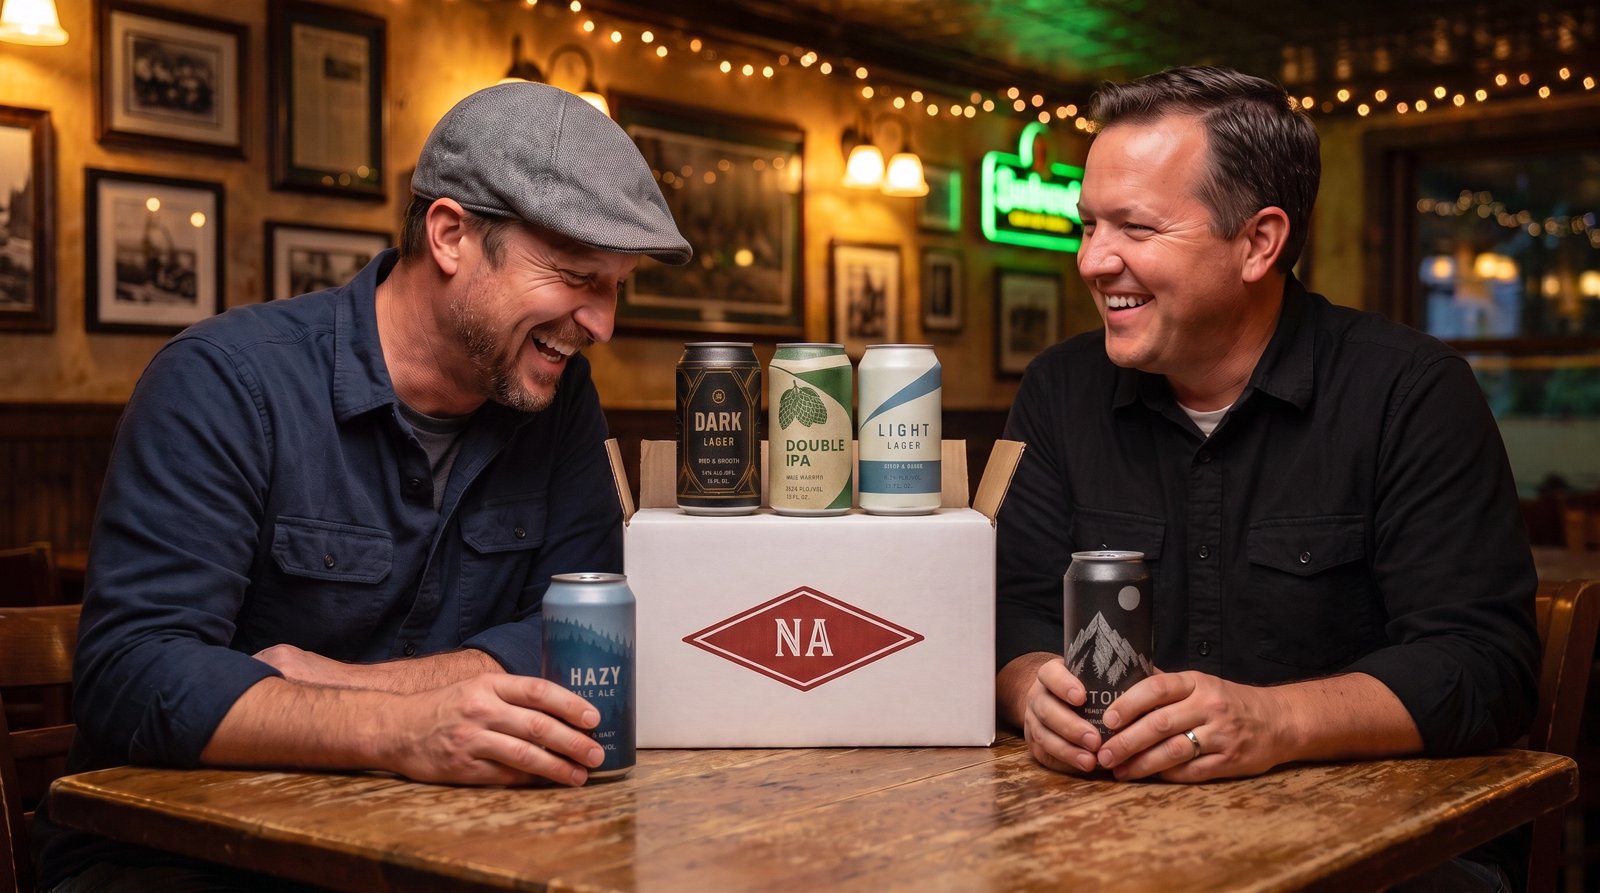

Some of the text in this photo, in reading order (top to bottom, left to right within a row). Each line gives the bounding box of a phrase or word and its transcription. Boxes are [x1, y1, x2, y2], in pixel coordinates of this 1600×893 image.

[695, 412, 742, 432] DARK
[878, 423, 930, 437] LIGHT
[703, 437, 735, 446] LAGER
[786, 439, 845, 451] DOUBLE
[887, 441, 921, 449] LAGER
[786, 454, 811, 467] IPA
[774, 618, 834, 657] NA
[570, 666, 621, 686] HAZY
[598, 689, 615, 697] ALE
